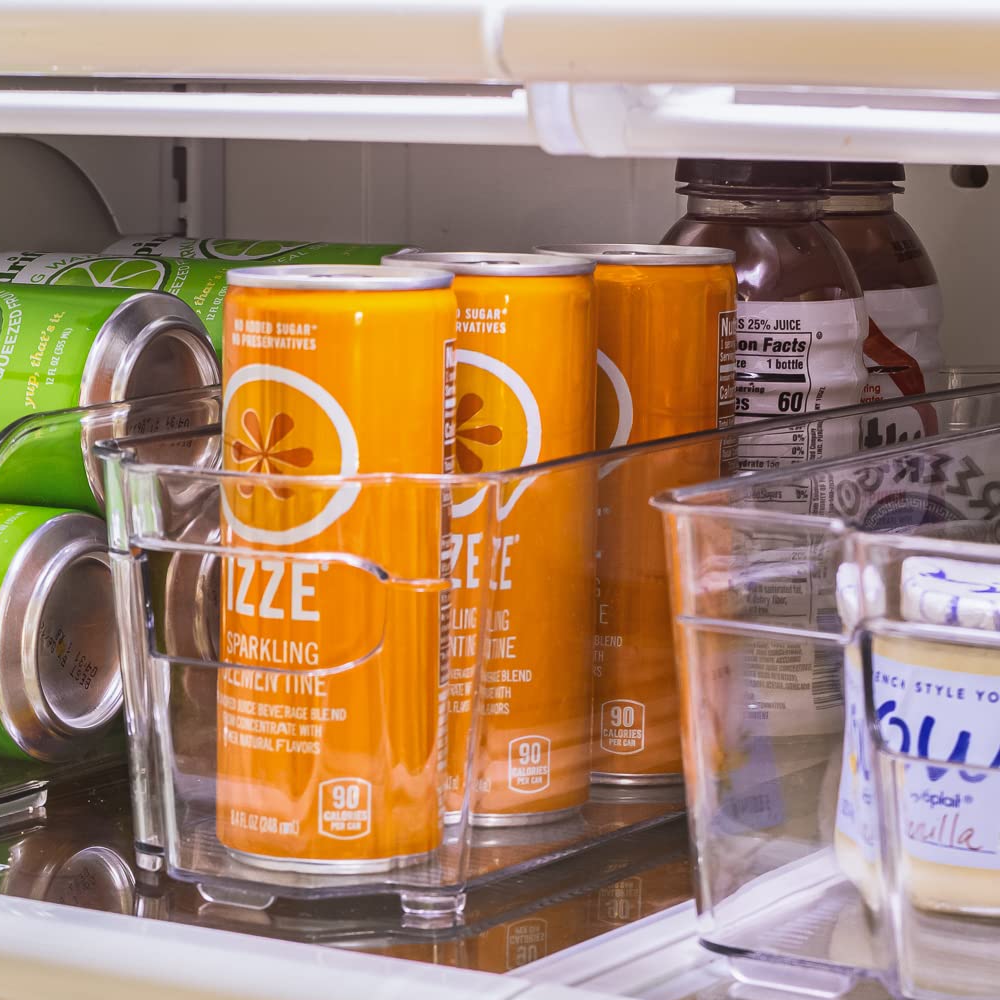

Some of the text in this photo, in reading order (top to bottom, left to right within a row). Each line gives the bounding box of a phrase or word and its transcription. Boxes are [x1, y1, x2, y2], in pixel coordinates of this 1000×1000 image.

[206, 312, 216, 321] 12
[456, 321, 507, 334] RVATIVES
[748, 319, 801, 331] 25% JUICE
[30, 325, 56, 367] that's
[55, 339, 66, 354] (355
[763, 337, 807, 353] Facts
[51, 354, 61, 365] OZ
[767, 359, 772, 369] 1
[776, 359, 804, 370] bottle
[48, 365, 57, 376] FL
[46, 377, 55, 385] 12
[25, 372, 40, 409] yup,
[778, 391, 804, 412] 60
[793, 434, 804, 442] 0%
[226, 553, 321, 622] IZZE
[226, 630, 319, 666] SPARKLING
[594, 635, 623, 648] BLEND
[500, 669, 532, 683] BLEND
[915, 682, 966, 700] STYLE
[310, 707, 347, 722] BLEND
[610, 705, 634, 728] 90
[603, 728, 642, 739] CALORIES
[609, 738, 636, 747] PER CAN
[519, 742, 541, 765] 90
[511, 764, 549, 777] CALORIES
[516, 775, 543, 785] PER CAN
[332, 784, 360, 810] 90
[323, 809, 368, 822] CALORIES
[330, 820, 362, 831] PER CAN
